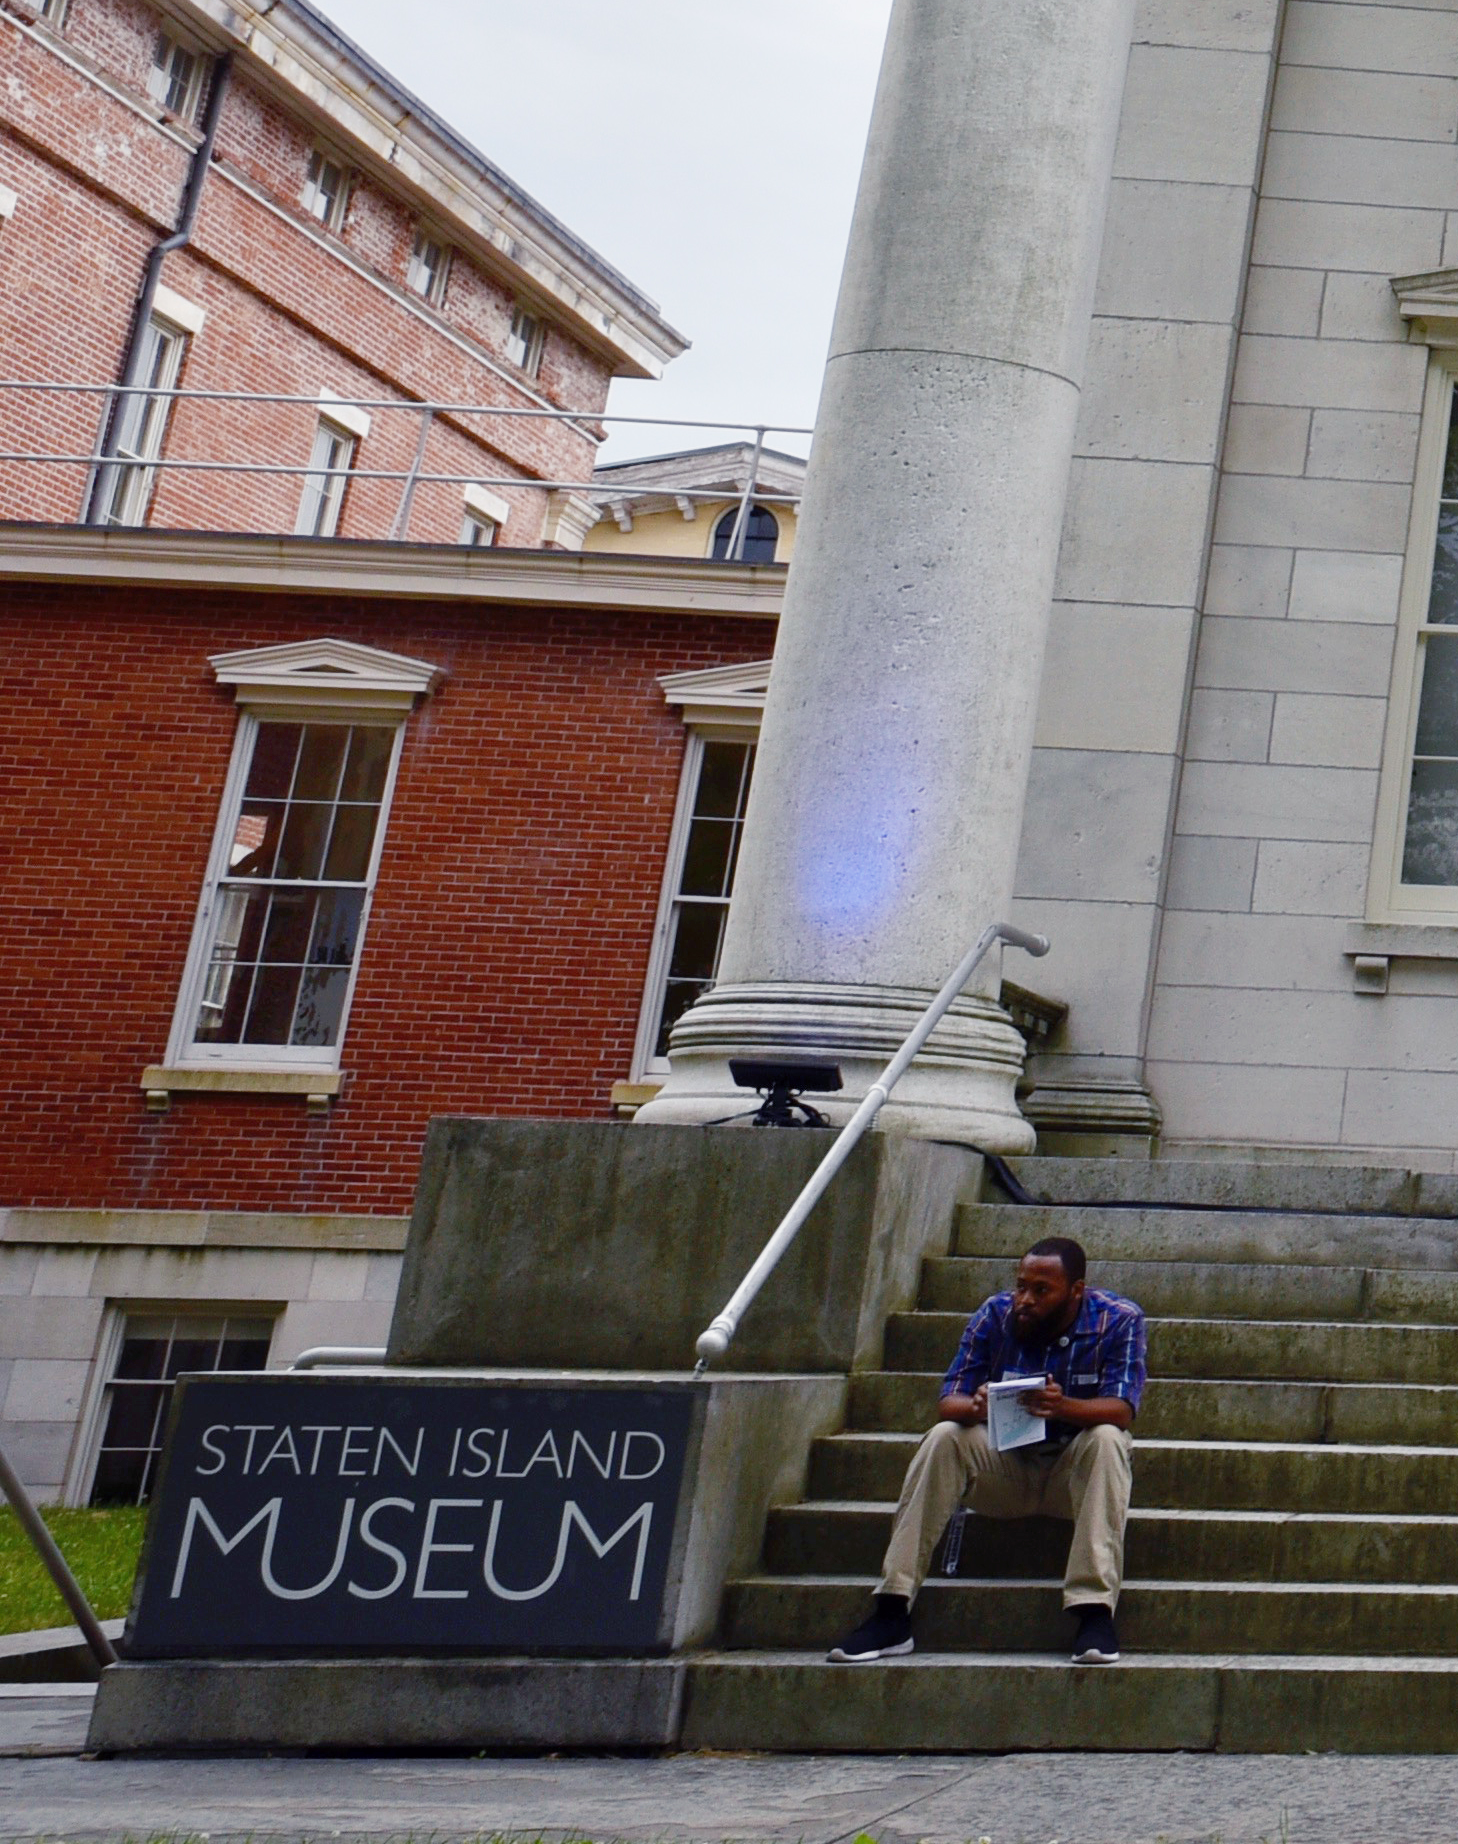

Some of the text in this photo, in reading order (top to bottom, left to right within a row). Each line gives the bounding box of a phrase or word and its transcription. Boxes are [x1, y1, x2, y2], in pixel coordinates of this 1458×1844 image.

[195, 1424, 667, 1480] STATEN ISLAND
[170, 1497, 655, 1602] MUSEUM
